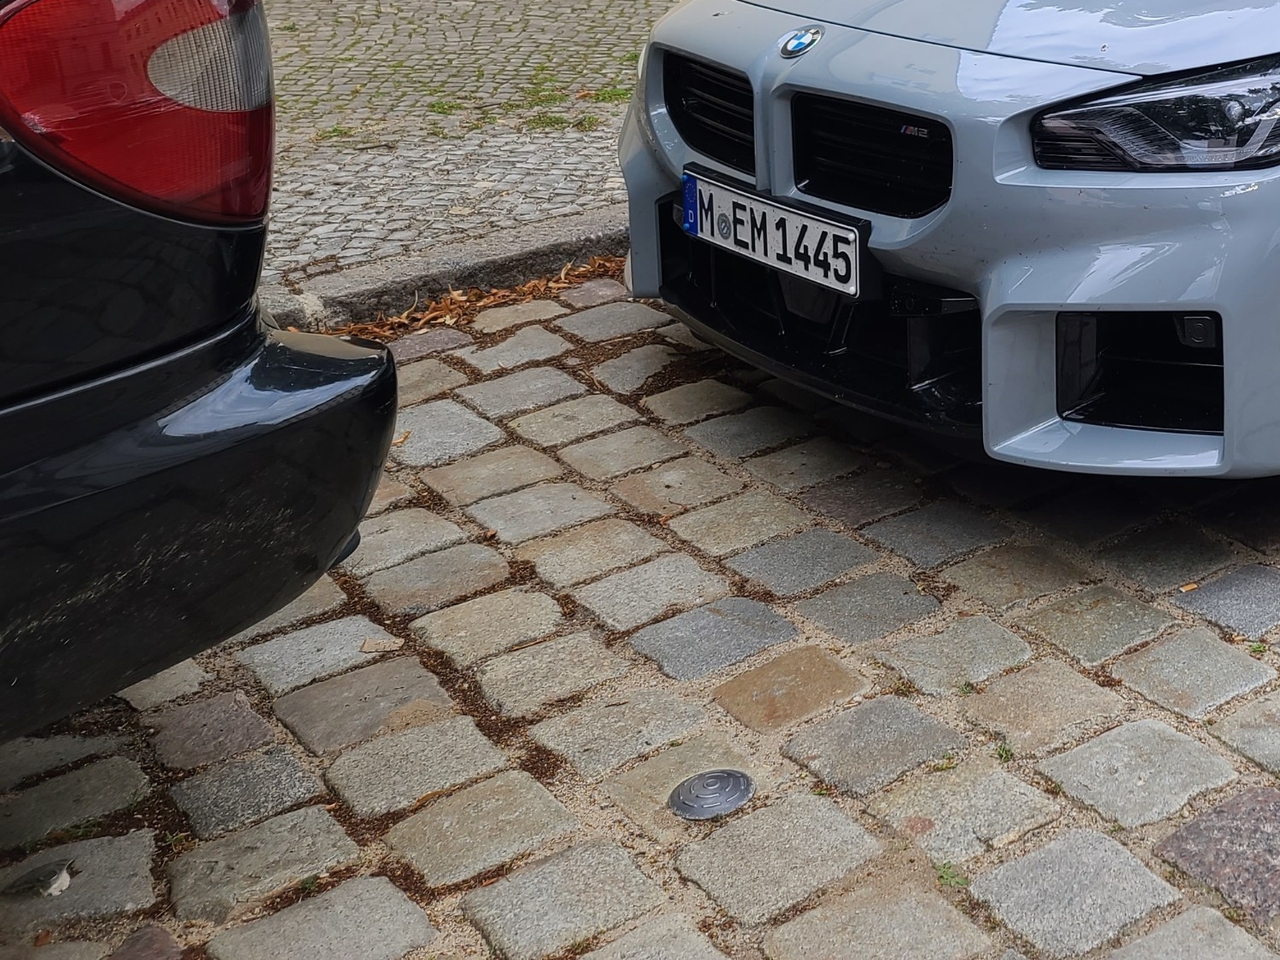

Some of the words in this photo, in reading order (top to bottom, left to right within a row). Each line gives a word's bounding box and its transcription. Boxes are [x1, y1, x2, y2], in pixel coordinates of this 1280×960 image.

[688, 209, 695, 223] D
[698, 188, 715, 237] M
[732, 201, 769, 258] EM
[775, 216, 852, 285] 1445
